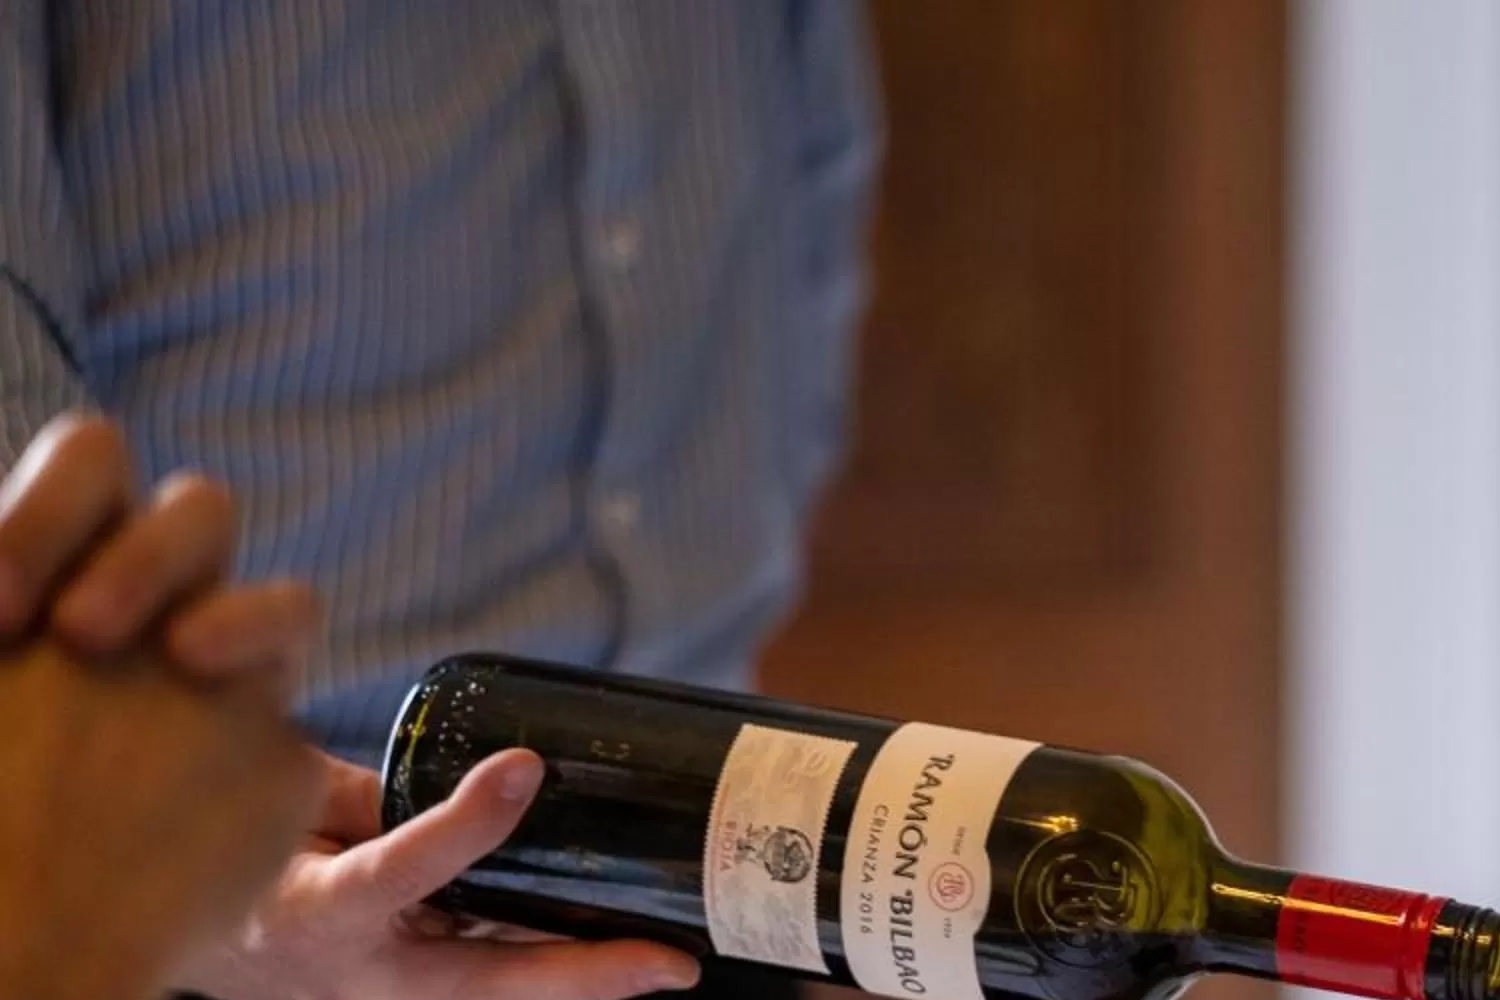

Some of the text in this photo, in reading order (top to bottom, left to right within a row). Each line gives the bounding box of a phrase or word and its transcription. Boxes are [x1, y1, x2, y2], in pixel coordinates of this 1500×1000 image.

[860, 803, 890, 883] CRIANZA
[892, 753, 956, 881] RAMÓN
[890, 890, 927, 995] BILBAO
